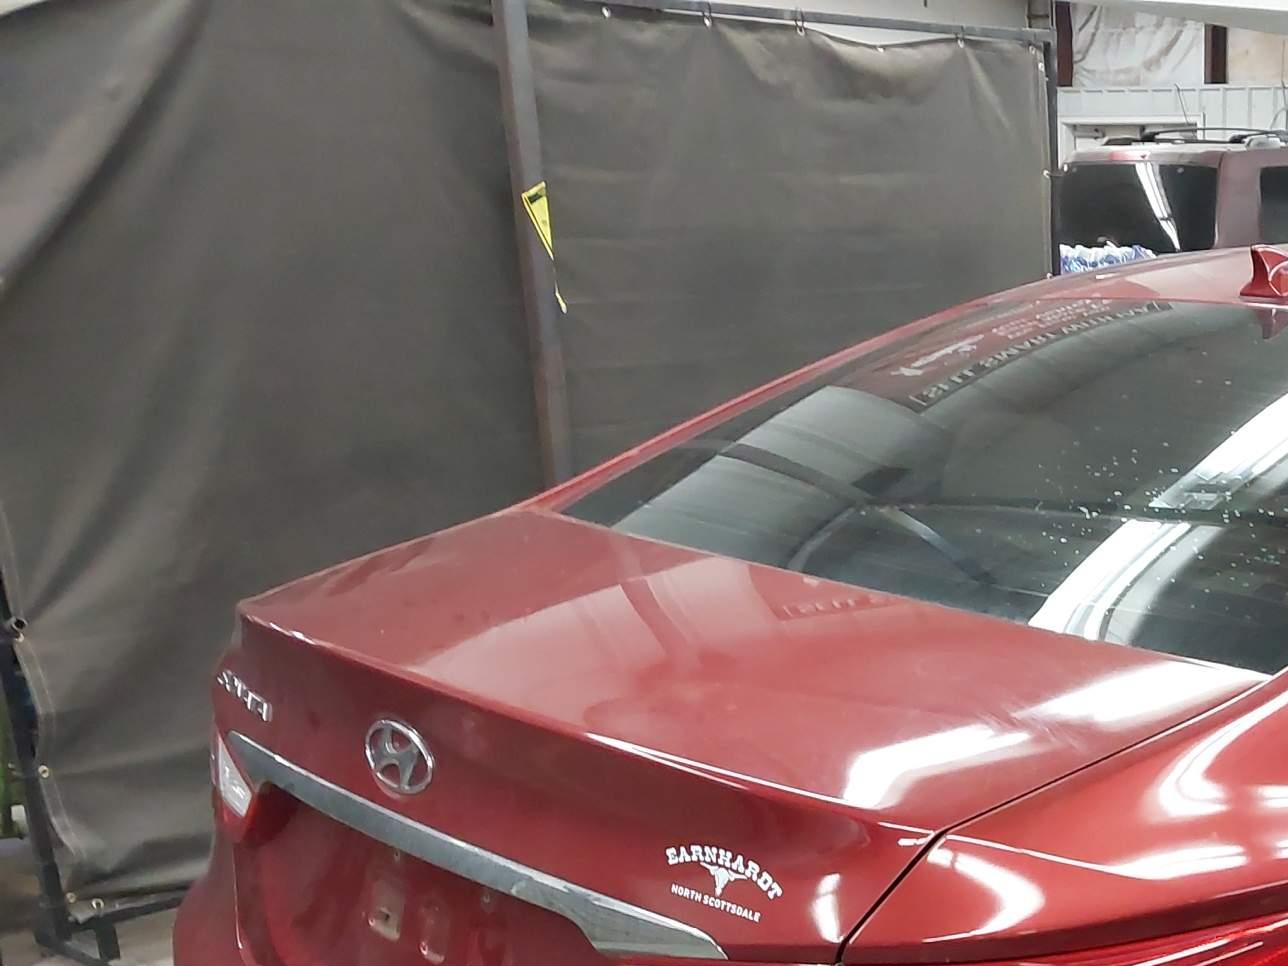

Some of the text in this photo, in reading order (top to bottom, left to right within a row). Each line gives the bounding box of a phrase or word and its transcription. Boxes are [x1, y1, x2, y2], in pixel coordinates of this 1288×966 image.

[665, 844, 783, 900] EARNHARDT
[671, 883, 761, 923] NORTH SCOTTSDALE
